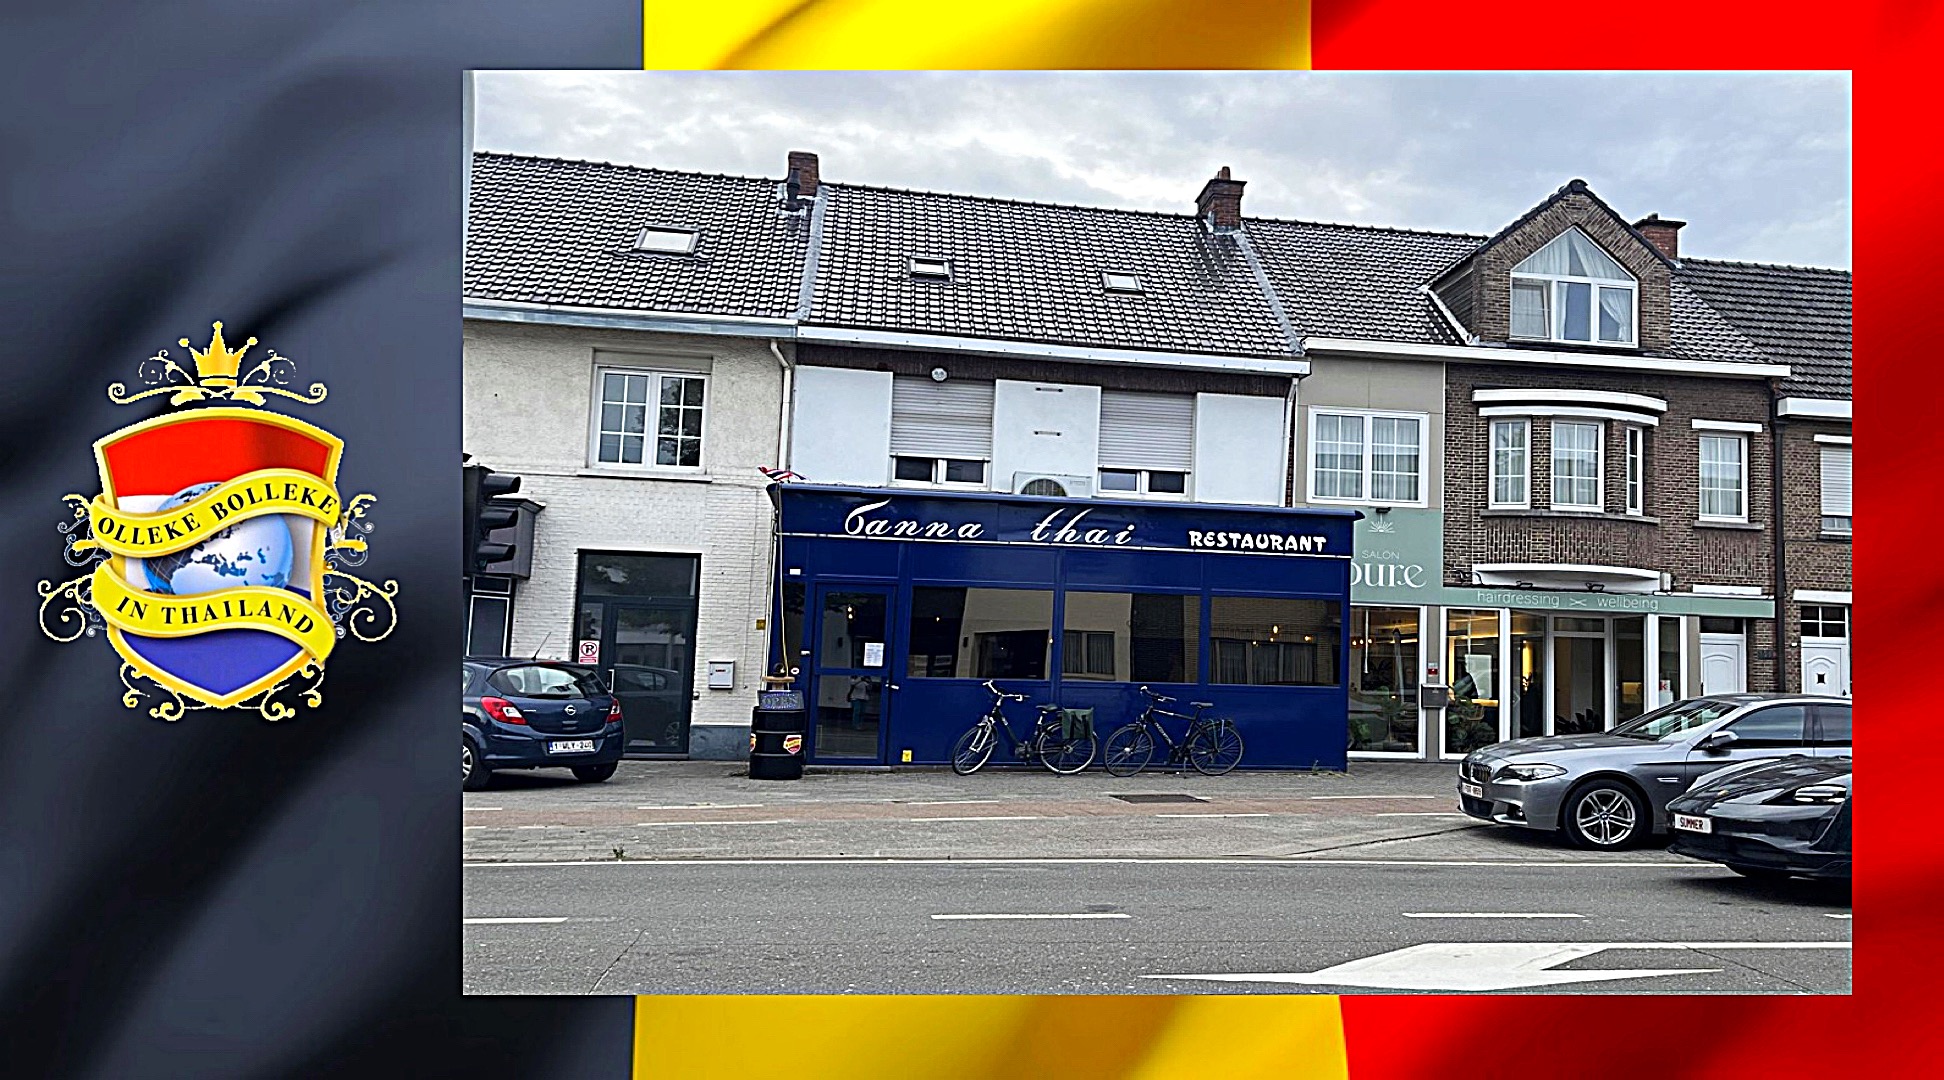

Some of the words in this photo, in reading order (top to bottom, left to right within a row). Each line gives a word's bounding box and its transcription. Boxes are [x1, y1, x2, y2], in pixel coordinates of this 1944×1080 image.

[1030, 507, 1136, 546] thai
[1188, 530, 1327, 554] RESTAURANT
[1361, 550, 1400, 560] SALON
[1477, 591, 1560, 607] hairdressing
[1597, 596, 1659, 611] wellbeing
[1680, 816, 1704, 831] SUMMER
